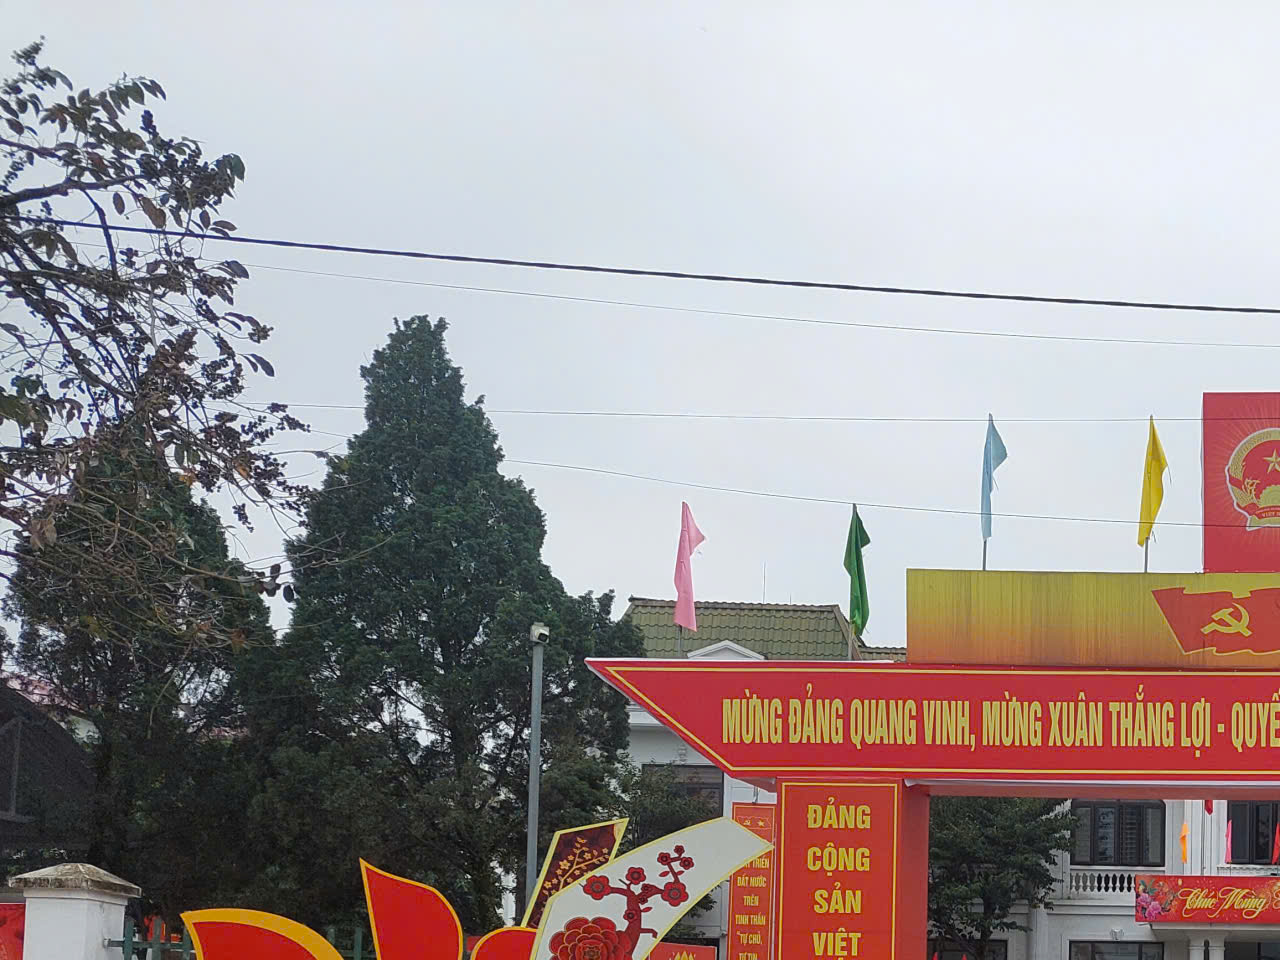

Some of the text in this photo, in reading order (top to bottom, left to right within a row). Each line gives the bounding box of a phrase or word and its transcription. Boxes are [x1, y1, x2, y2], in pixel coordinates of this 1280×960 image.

[722, 689, 782, 744] MỪNG
[788, 683, 843, 744] ĐẢNG
[850, 699, 917, 749] QUANG
[922, 700, 976, 751] VINH,
[982, 691, 1043, 747] MỪNG
[1048, 693, 1102, 747] XUÂN
[1108, 685, 1175, 747] THẮNG
[1180, 697, 1211, 757] LỢI
[807, 797, 871, 829] ĐẢNG
[807, 842, 870, 876] CỘNG
[813, 881, 862, 914] SẢN
[1178, 888, 1218, 917] Chúc
[1208, 886, 1271, 918] Mừng
[812, 928, 861, 960] VIỆT
